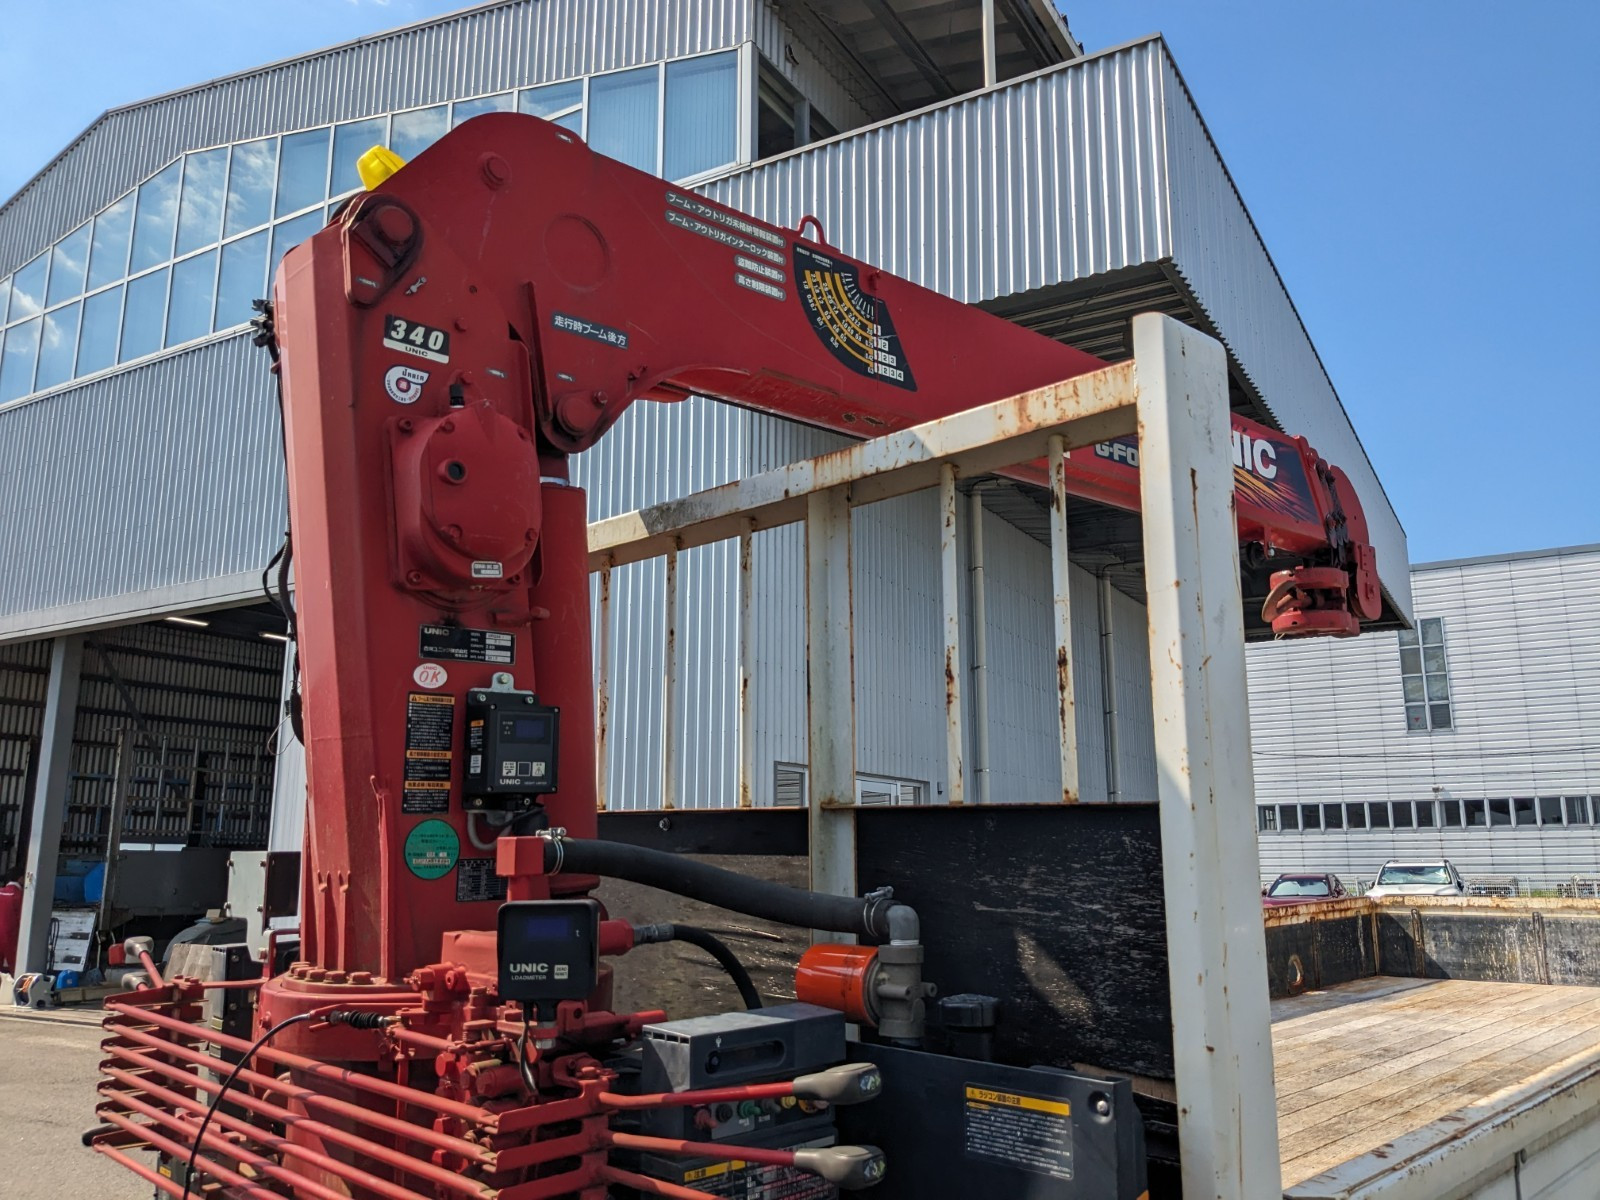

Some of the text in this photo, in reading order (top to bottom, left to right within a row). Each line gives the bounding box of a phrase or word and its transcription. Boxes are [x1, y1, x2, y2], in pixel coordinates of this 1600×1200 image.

[390, 319, 445, 351] 340
[554, 315, 627, 346] 走行時ブーム後方
[405, 346, 428, 357] UNIC
[424, 627, 450, 636] UNIC
[419, 670, 441, 683] OK
[575, 929, 580, 937] t
[509, 962, 549, 973] UNIC
